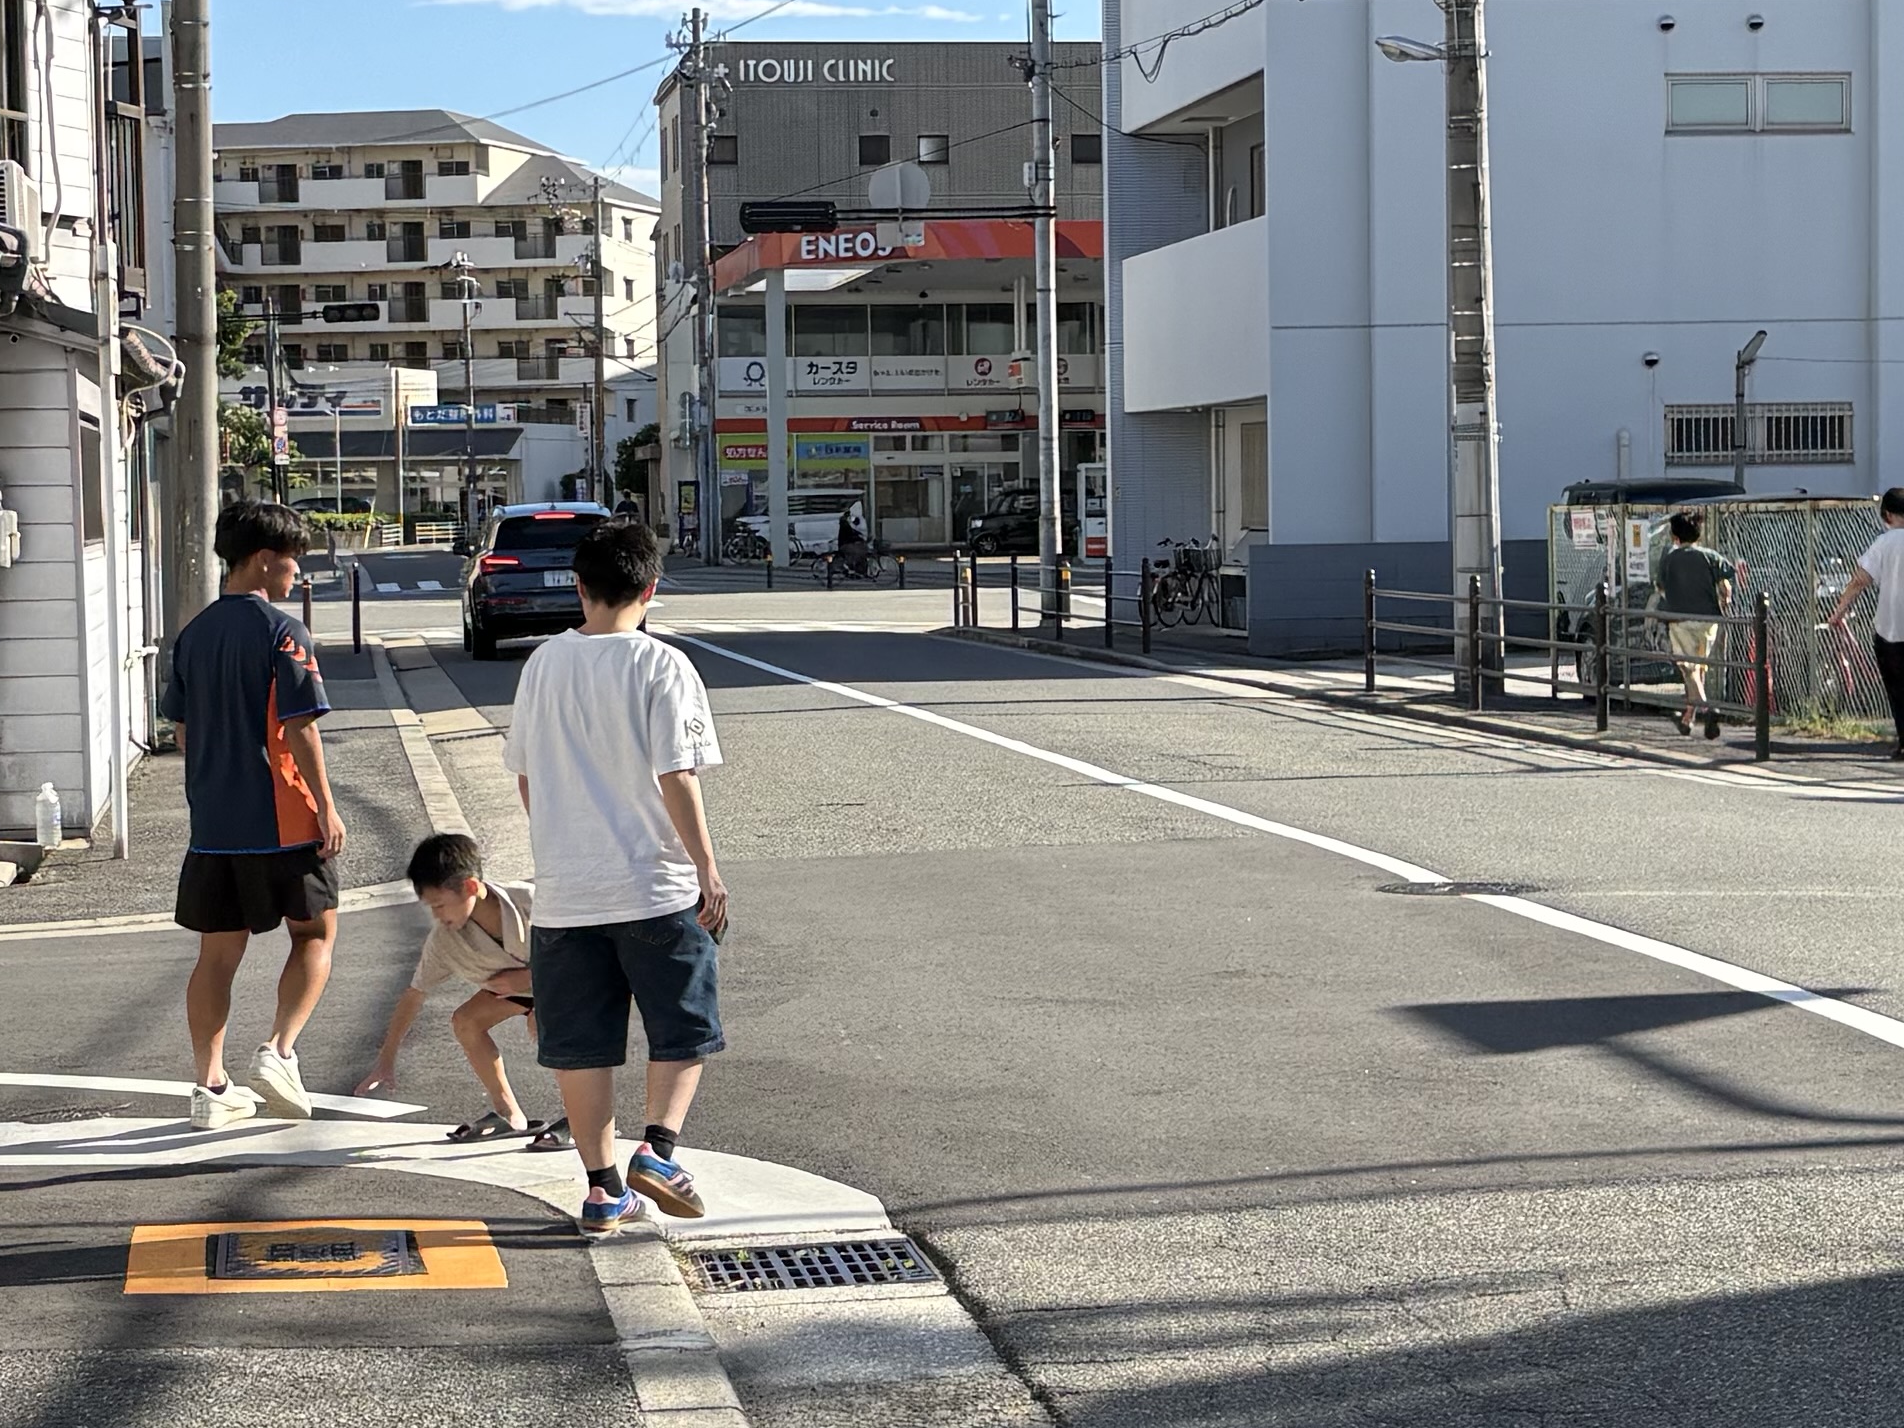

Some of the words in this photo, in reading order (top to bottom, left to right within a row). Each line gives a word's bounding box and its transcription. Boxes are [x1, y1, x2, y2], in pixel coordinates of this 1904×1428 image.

[739, 59, 813, 83] ITOUJI
[823, 58, 895, 82] CLINIC
[806, 361, 858, 376] カースタ
[851, 420, 888, 430] Service
[890, 420, 920, 430] Room
